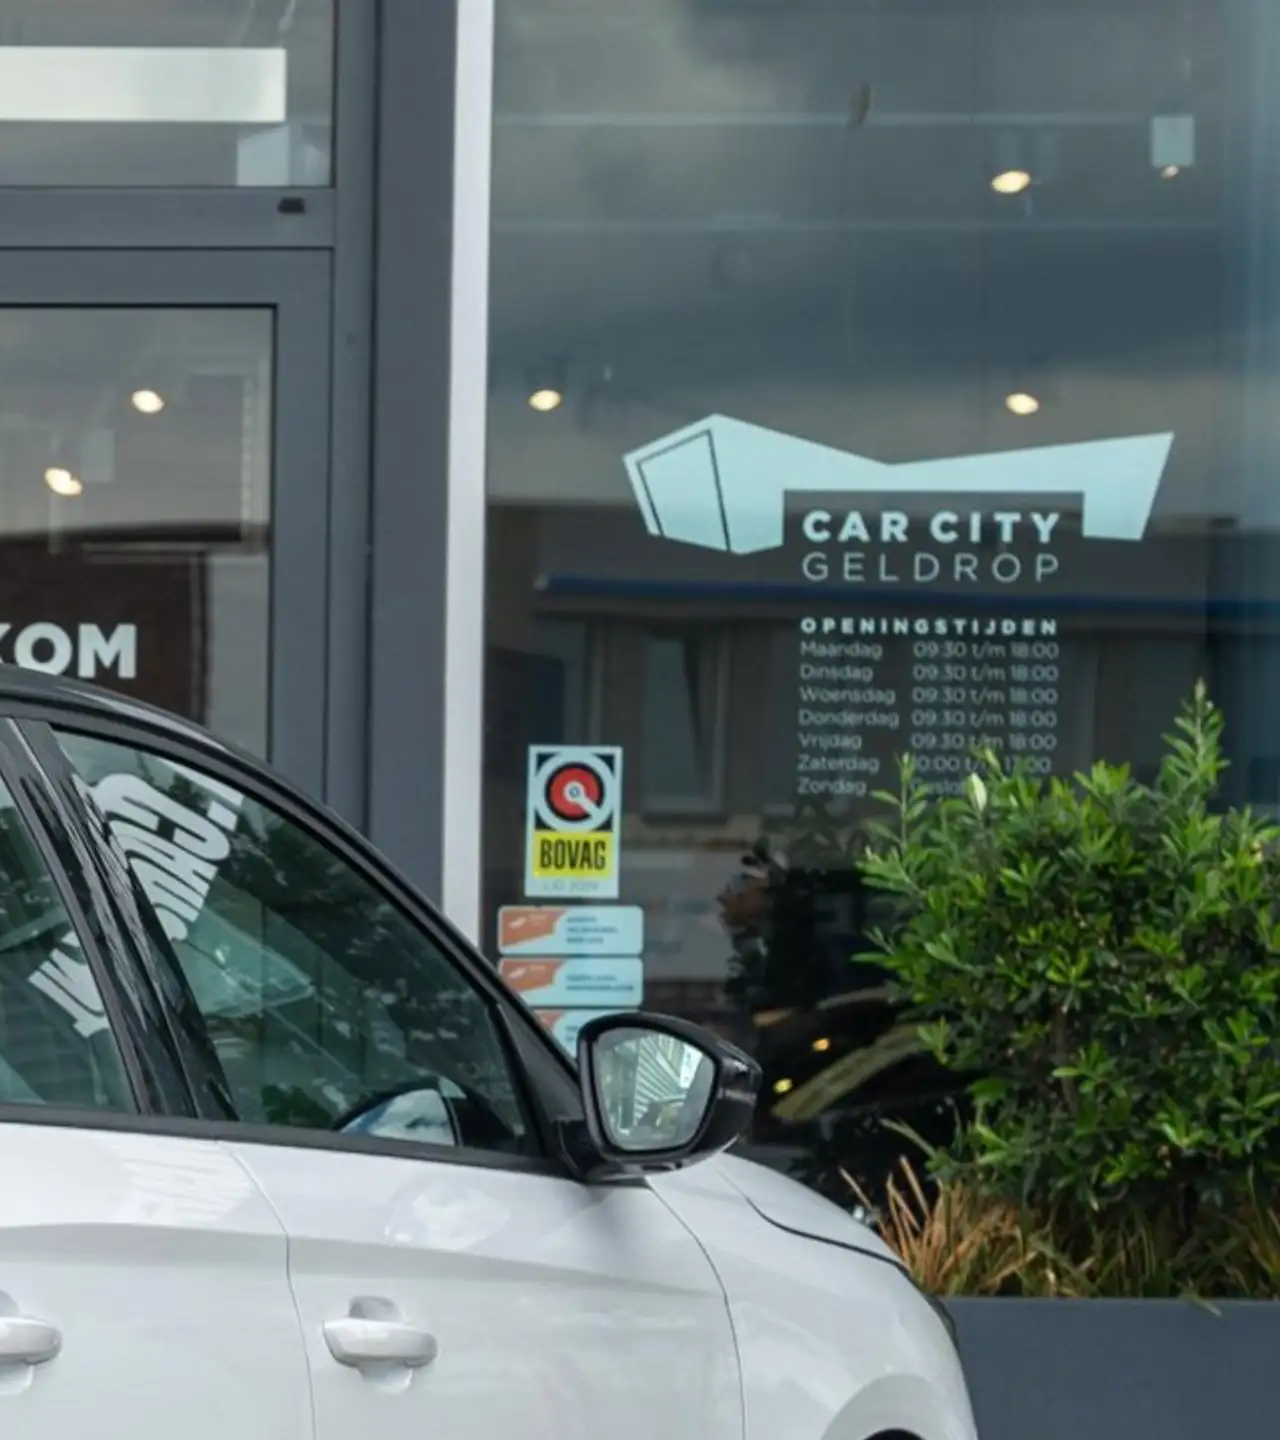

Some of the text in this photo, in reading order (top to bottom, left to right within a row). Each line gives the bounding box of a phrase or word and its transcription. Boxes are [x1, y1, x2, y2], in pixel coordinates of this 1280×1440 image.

[802, 510, 1060, 543] CAR CITY
[802, 552, 1059, 583] GELDROP
[800, 617, 1058, 636] OPENINGSTIJDEN
[800, 641, 883, 661] Maandag
[971, 640, 1006, 659] t/m
[800, 664, 873, 683] Dinsdag
[971, 663, 1006, 682] t/m
[799, 686, 896, 706] Woensdag
[969, 686, 1006, 705] t/m
[798, 709, 900, 730] Donderdag
[969, 709, 1004, 729] t/m
[798, 732, 862, 751] Vrijdag
[797, 754, 880, 775] Zaterdag
[913, 755, 960, 773] 0:00
[797, 777, 867, 797] Zondag
[540, 838, 607, 871] BOVAG
